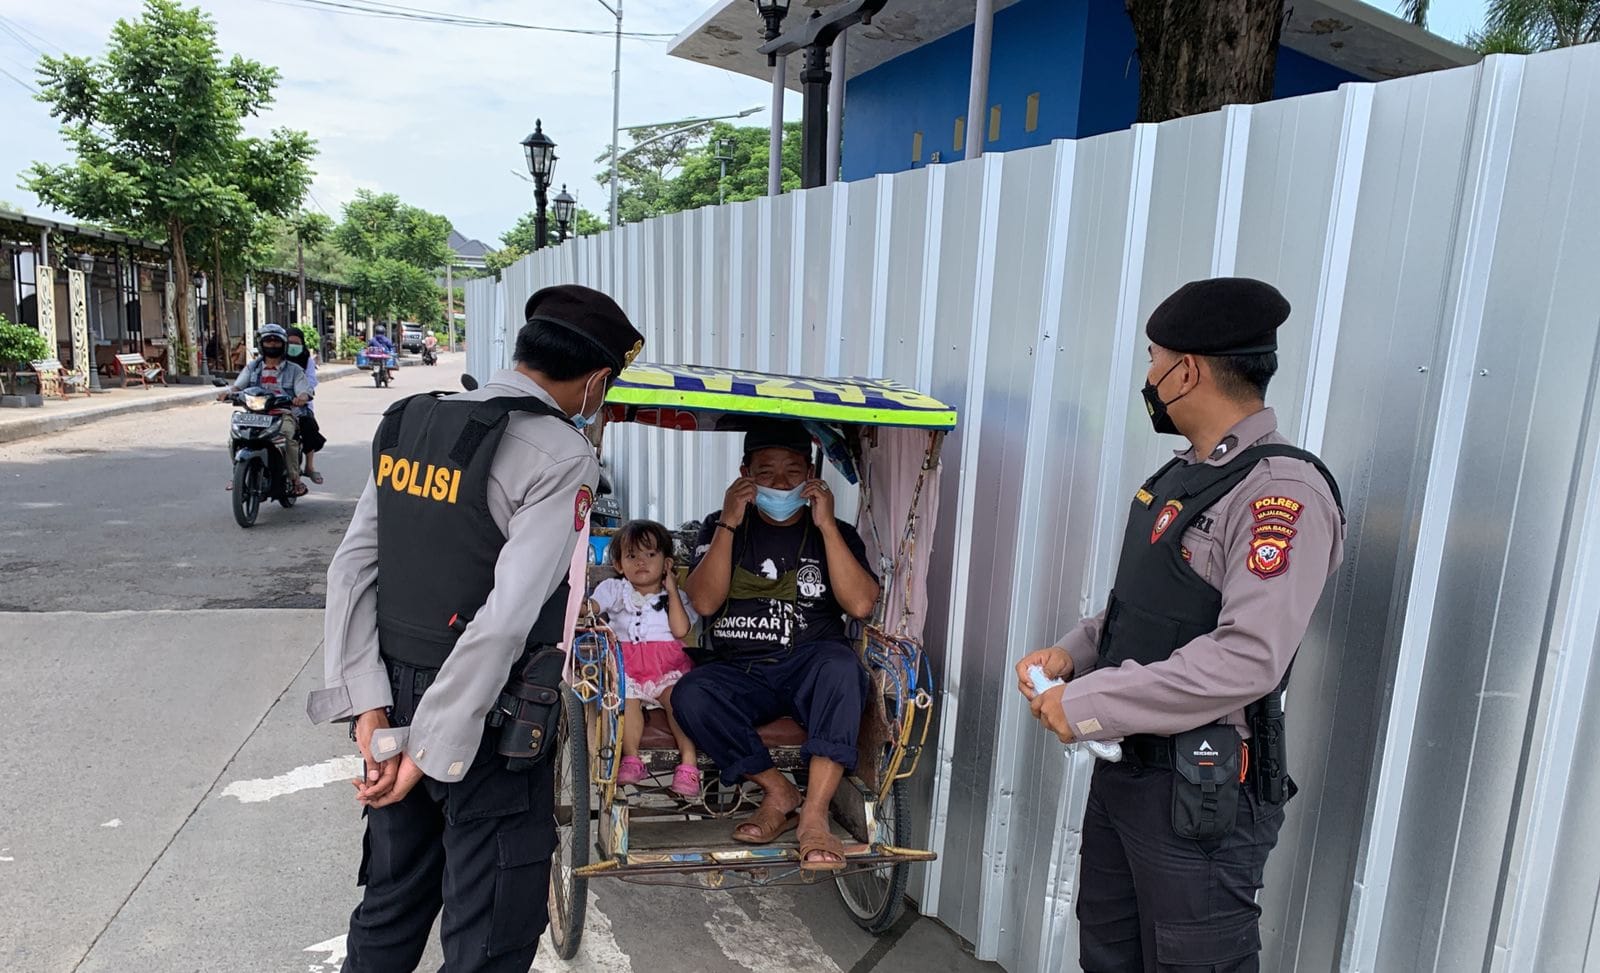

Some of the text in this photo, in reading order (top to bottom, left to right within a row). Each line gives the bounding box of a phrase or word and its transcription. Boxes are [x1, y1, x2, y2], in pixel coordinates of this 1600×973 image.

[377, 454, 461, 504] POLISI
[1255, 497, 1299, 511] POLRES
[1193, 514, 1214, 533] RI
[1255, 525, 1293, 536] JAWA BARAT
[749, 631, 778, 641] LAMA
